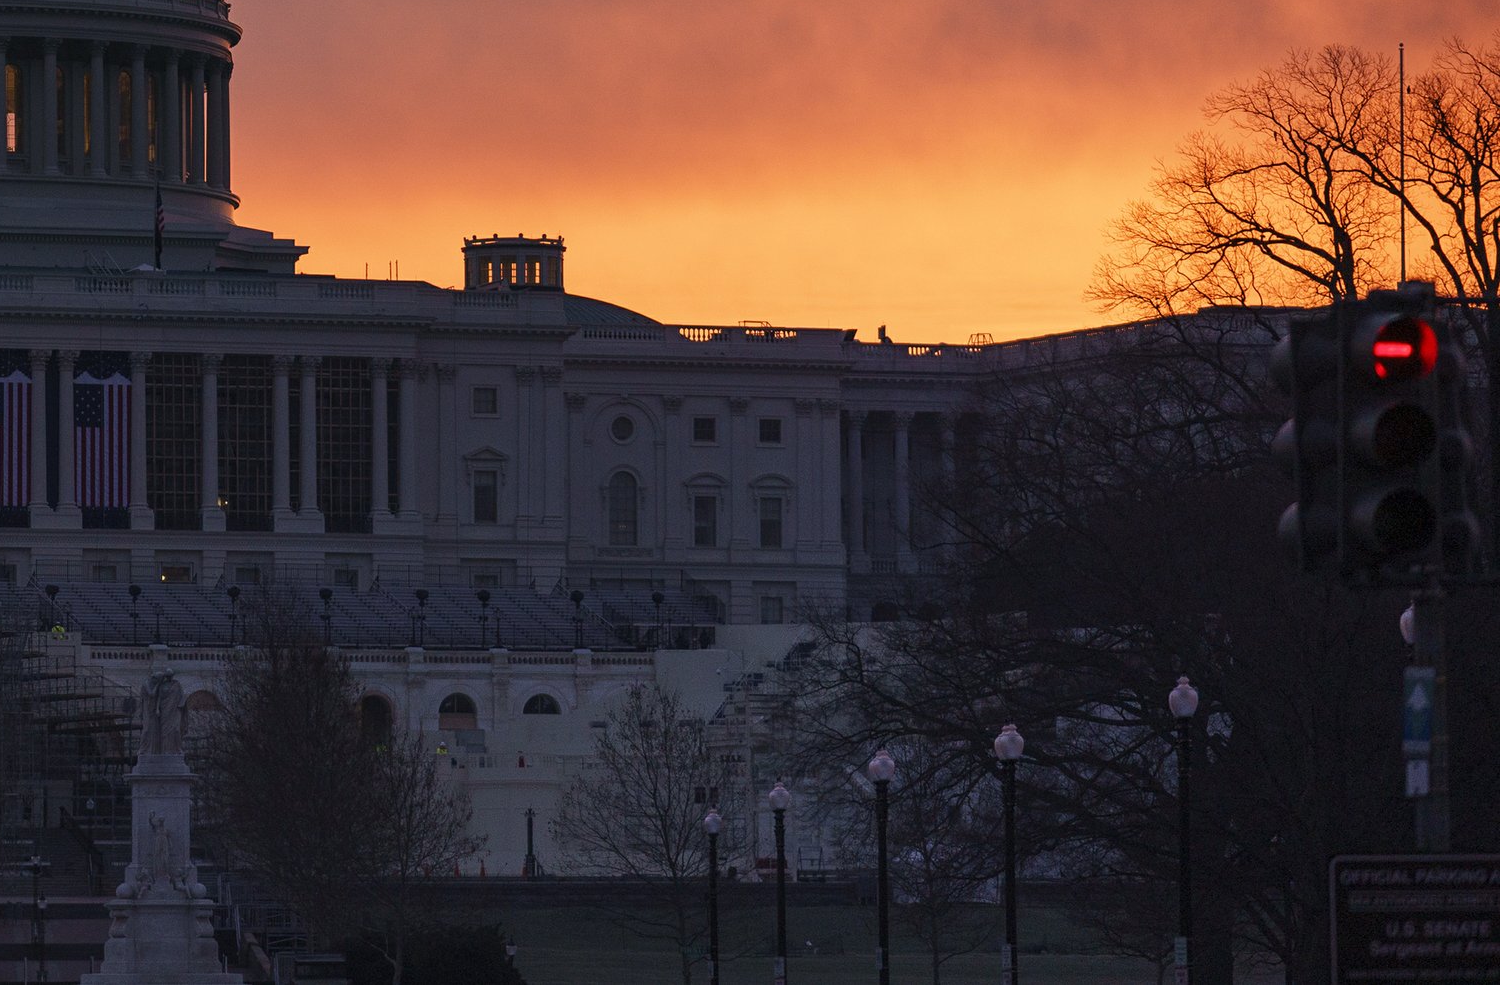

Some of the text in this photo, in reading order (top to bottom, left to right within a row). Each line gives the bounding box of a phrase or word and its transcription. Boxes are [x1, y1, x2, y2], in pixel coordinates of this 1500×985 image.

[1340, 869, 1411, 885] OFFICIAL
[1415, 869, 1487, 884] PARKING
[1423, 920, 1491, 937] SENATE
